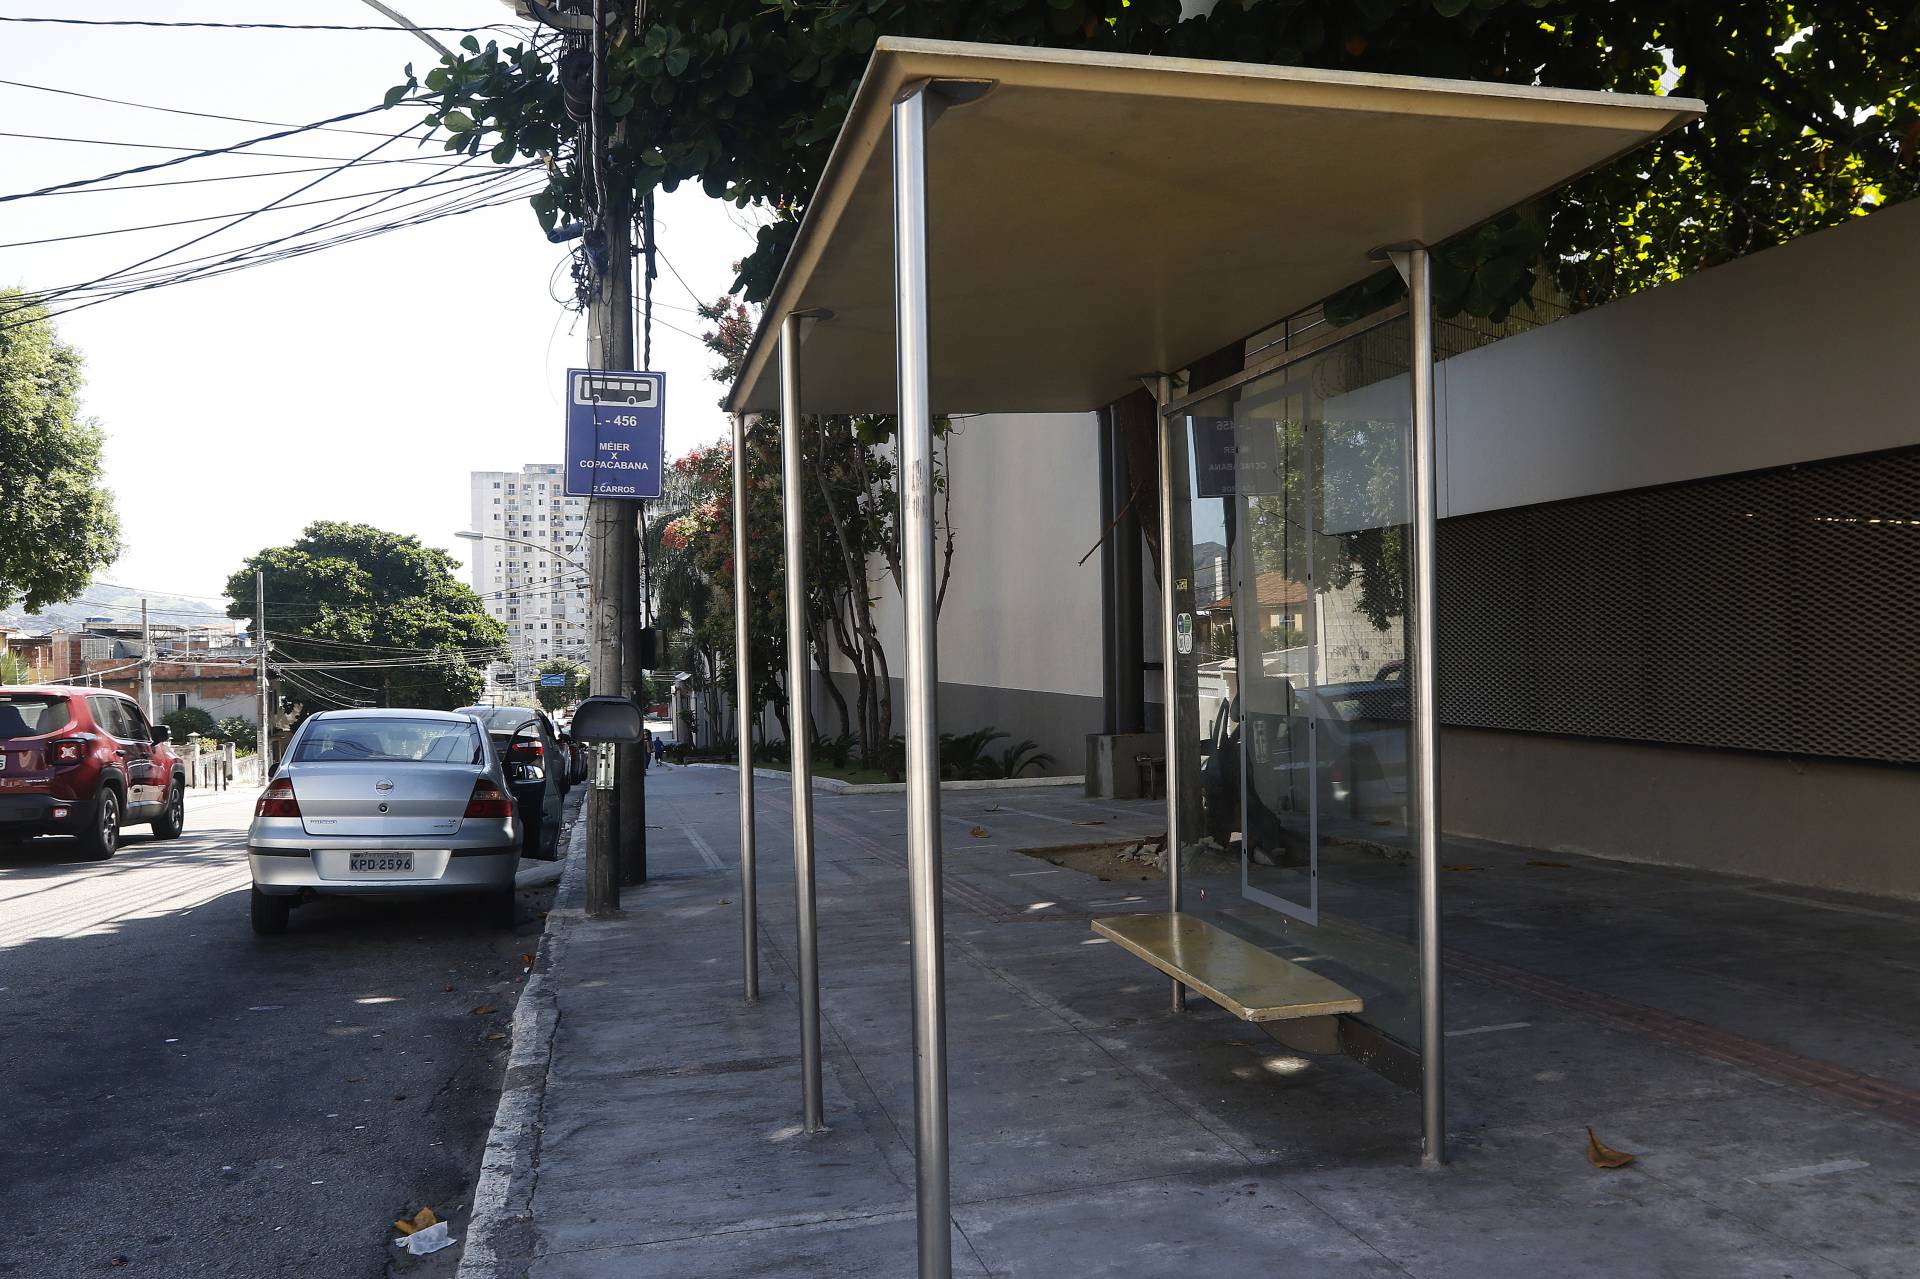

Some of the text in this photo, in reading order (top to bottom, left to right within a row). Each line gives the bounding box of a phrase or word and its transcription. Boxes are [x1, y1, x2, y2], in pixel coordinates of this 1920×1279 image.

[613, 415, 637, 426] 456
[599, 441, 630, 452] MÉIER
[611, 452, 618, 460] X
[579, 460, 649, 470] COPACABANA
[599, 485, 636, 493] CARROS
